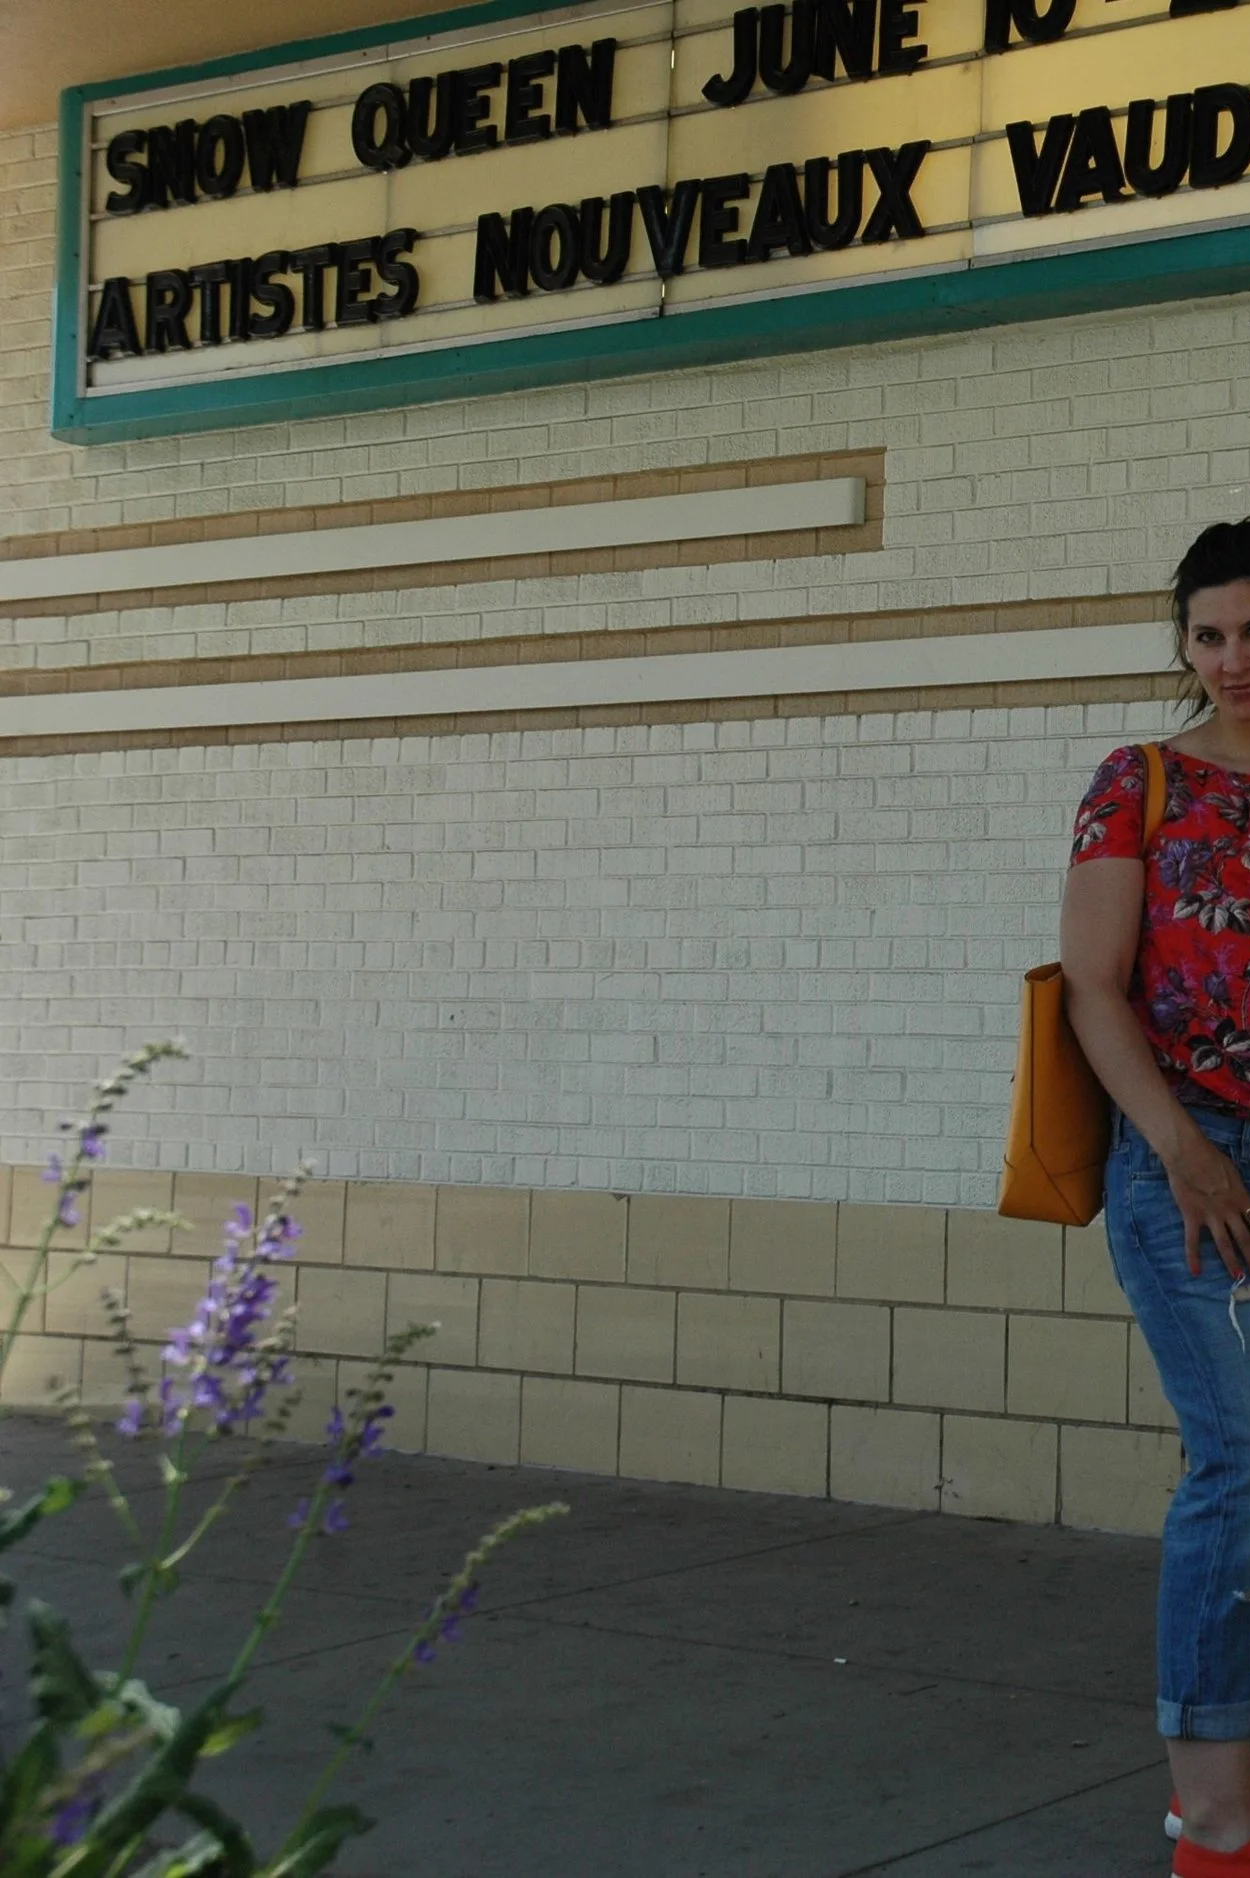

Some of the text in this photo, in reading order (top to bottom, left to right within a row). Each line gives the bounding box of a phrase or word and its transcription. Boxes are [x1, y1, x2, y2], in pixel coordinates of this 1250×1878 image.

[105, 100, 312, 214] SNOW
[351, 38, 617, 172] QUEEN
[702, 0, 928, 107] JUNE
[86, 228, 419, 362] ARTISTES
[473, 140, 932, 304] NOUVEAUX
